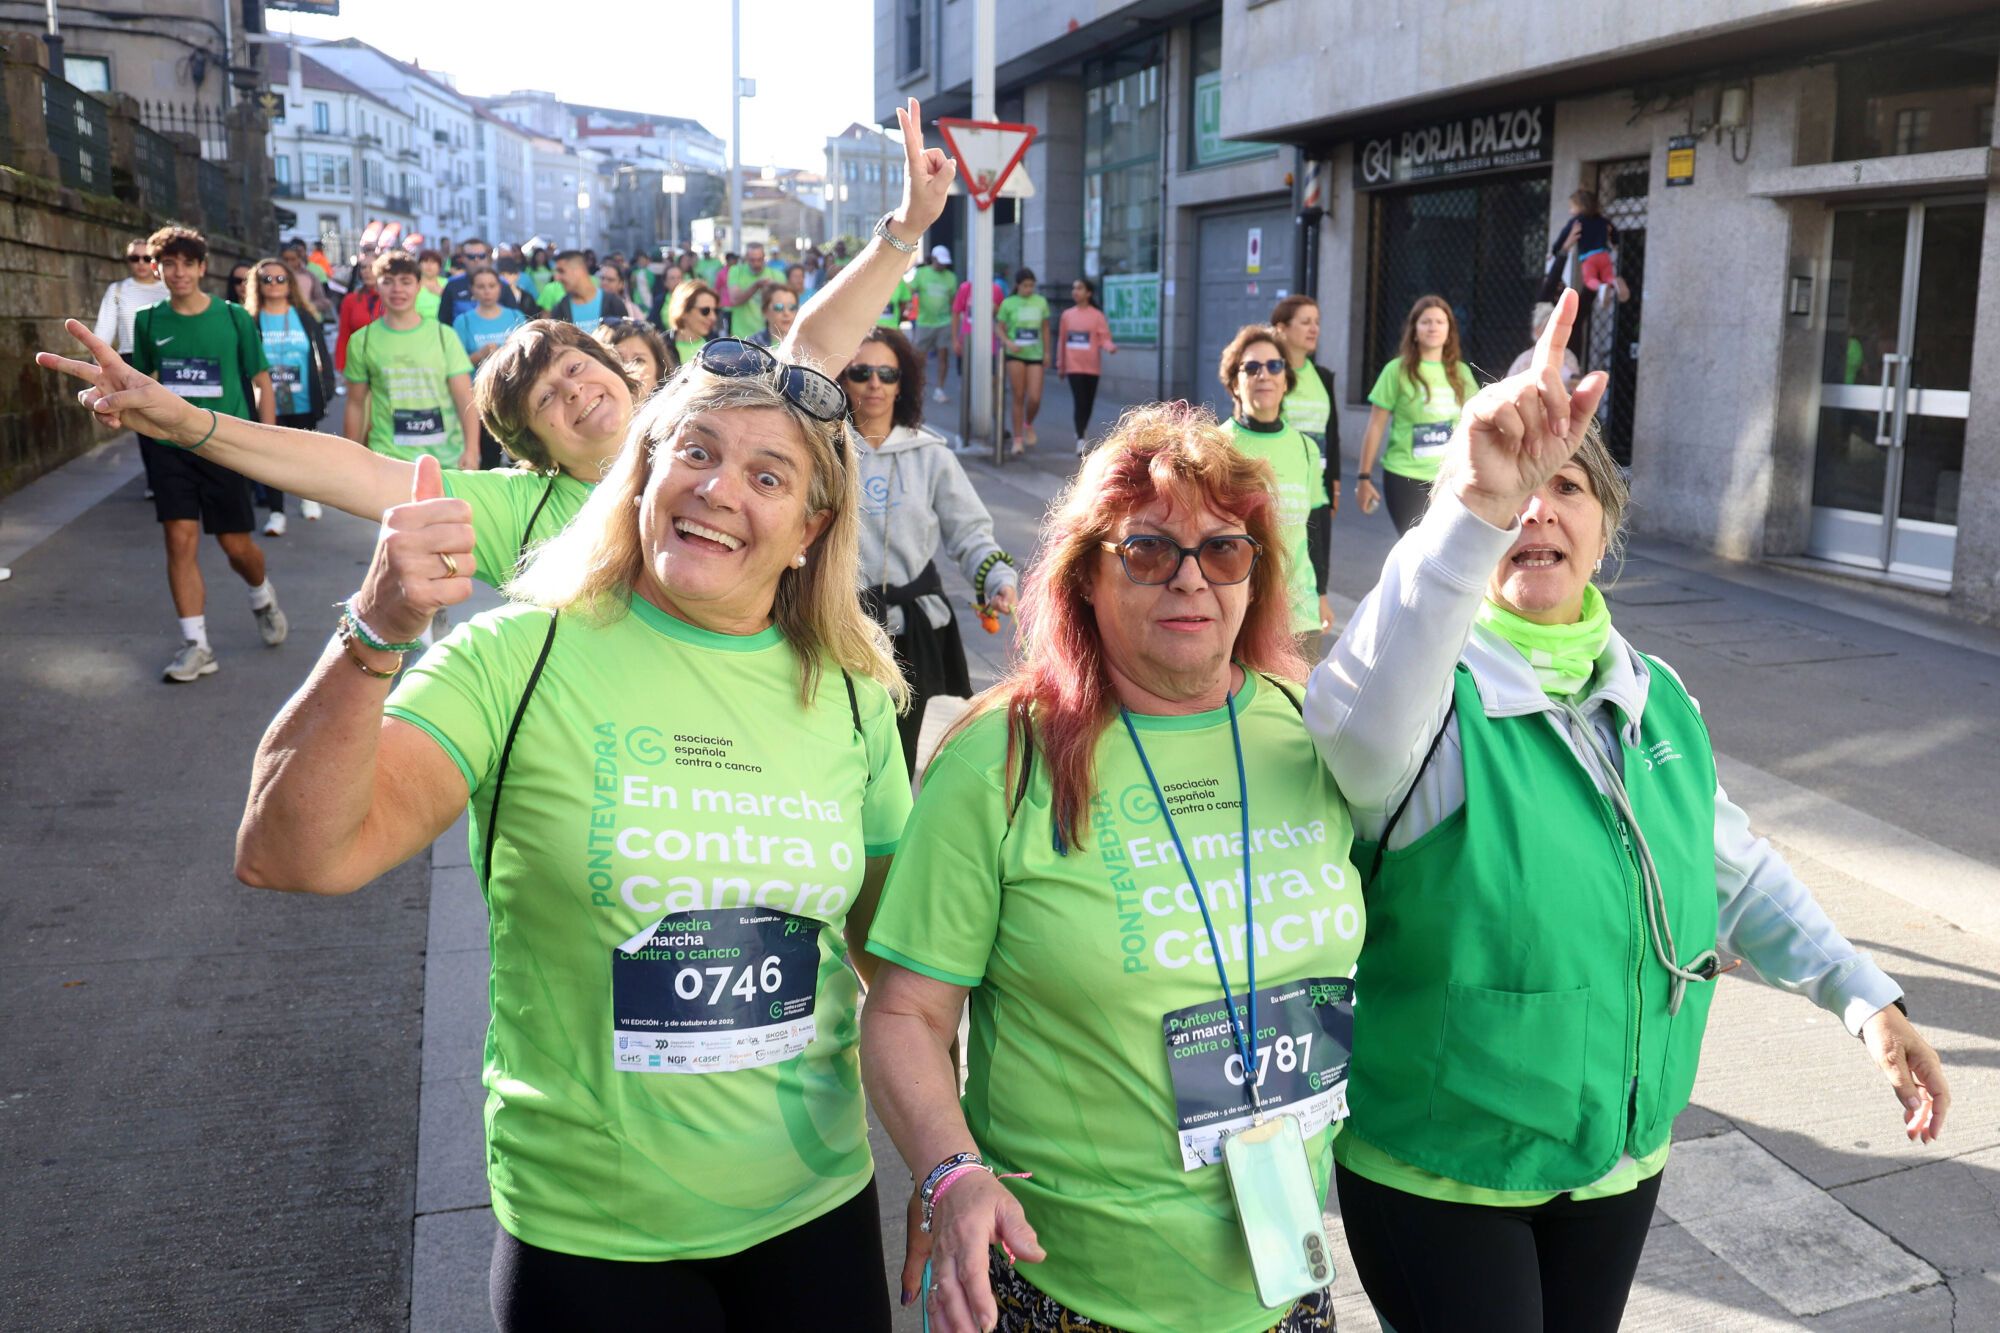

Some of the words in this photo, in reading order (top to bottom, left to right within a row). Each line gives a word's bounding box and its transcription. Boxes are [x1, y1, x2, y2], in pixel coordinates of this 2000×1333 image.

[1400, 122, 1465, 166] BORJA
[1471, 106, 1542, 155] PAZOS
[176, 369, 207, 381] 1872
[673, 733, 733, 747] asociación
[674, 744, 726, 758] española
[675, 757, 712, 768] contra
[715, 761, 722, 769] o
[724, 761, 762, 773] cancro
[1163, 778, 1219, 792] asociación
[623, 775, 678, 809] En
[691, 788, 844, 822] marcha
[1167, 789, 1215, 804] española
[588, 721, 618, 908] PONTEVEDRA
[1170, 803, 1204, 816] contra
[1207, 803, 1213, 811] o
[1215, 800, 1243, 809] cancr
[616, 825, 816, 869] contra
[830, 841, 852, 872] o
[1127, 836, 1182, 868] En
[1191, 820, 1326, 861] marcha
[1092, 789, 1149, 974] PONTEVEDRA
[1142, 868, 1315, 916] contra
[1320, 863, 1345, 890] o
[620, 874, 847, 916] cancro
[658, 919, 711, 932] evedra
[739, 917, 749, 925] Eu
[1153, 903, 1359, 969] cancro
[620, 948, 671, 960] contra
[675, 951, 685, 960] o
[689, 947, 740, 959] cancro
[674, 955, 782, 1006] 0746
[1270, 996, 1279, 1004] Eu
[1311, 993, 1328, 1009] 70
[630, 1018, 659, 1026] EDICIÓN
[1192, 1019, 1244, 1040] marcha
[1174, 1040, 1218, 1059] contra
[1221, 1038, 1230, 1048] o
[1233, 1027, 1276, 1046] cacro
[620, 1054, 641, 1062] CHS
[667, 1056, 686, 1064] NGP
[698, 1055, 720, 1063] caser
[1224, 1032, 1313, 1087] 0787
[1193, 1110, 1219, 1122] EDICIÓN
[1237, 1104, 1251, 1112] outu
[1269, 1095, 1282, 1104] 2025
